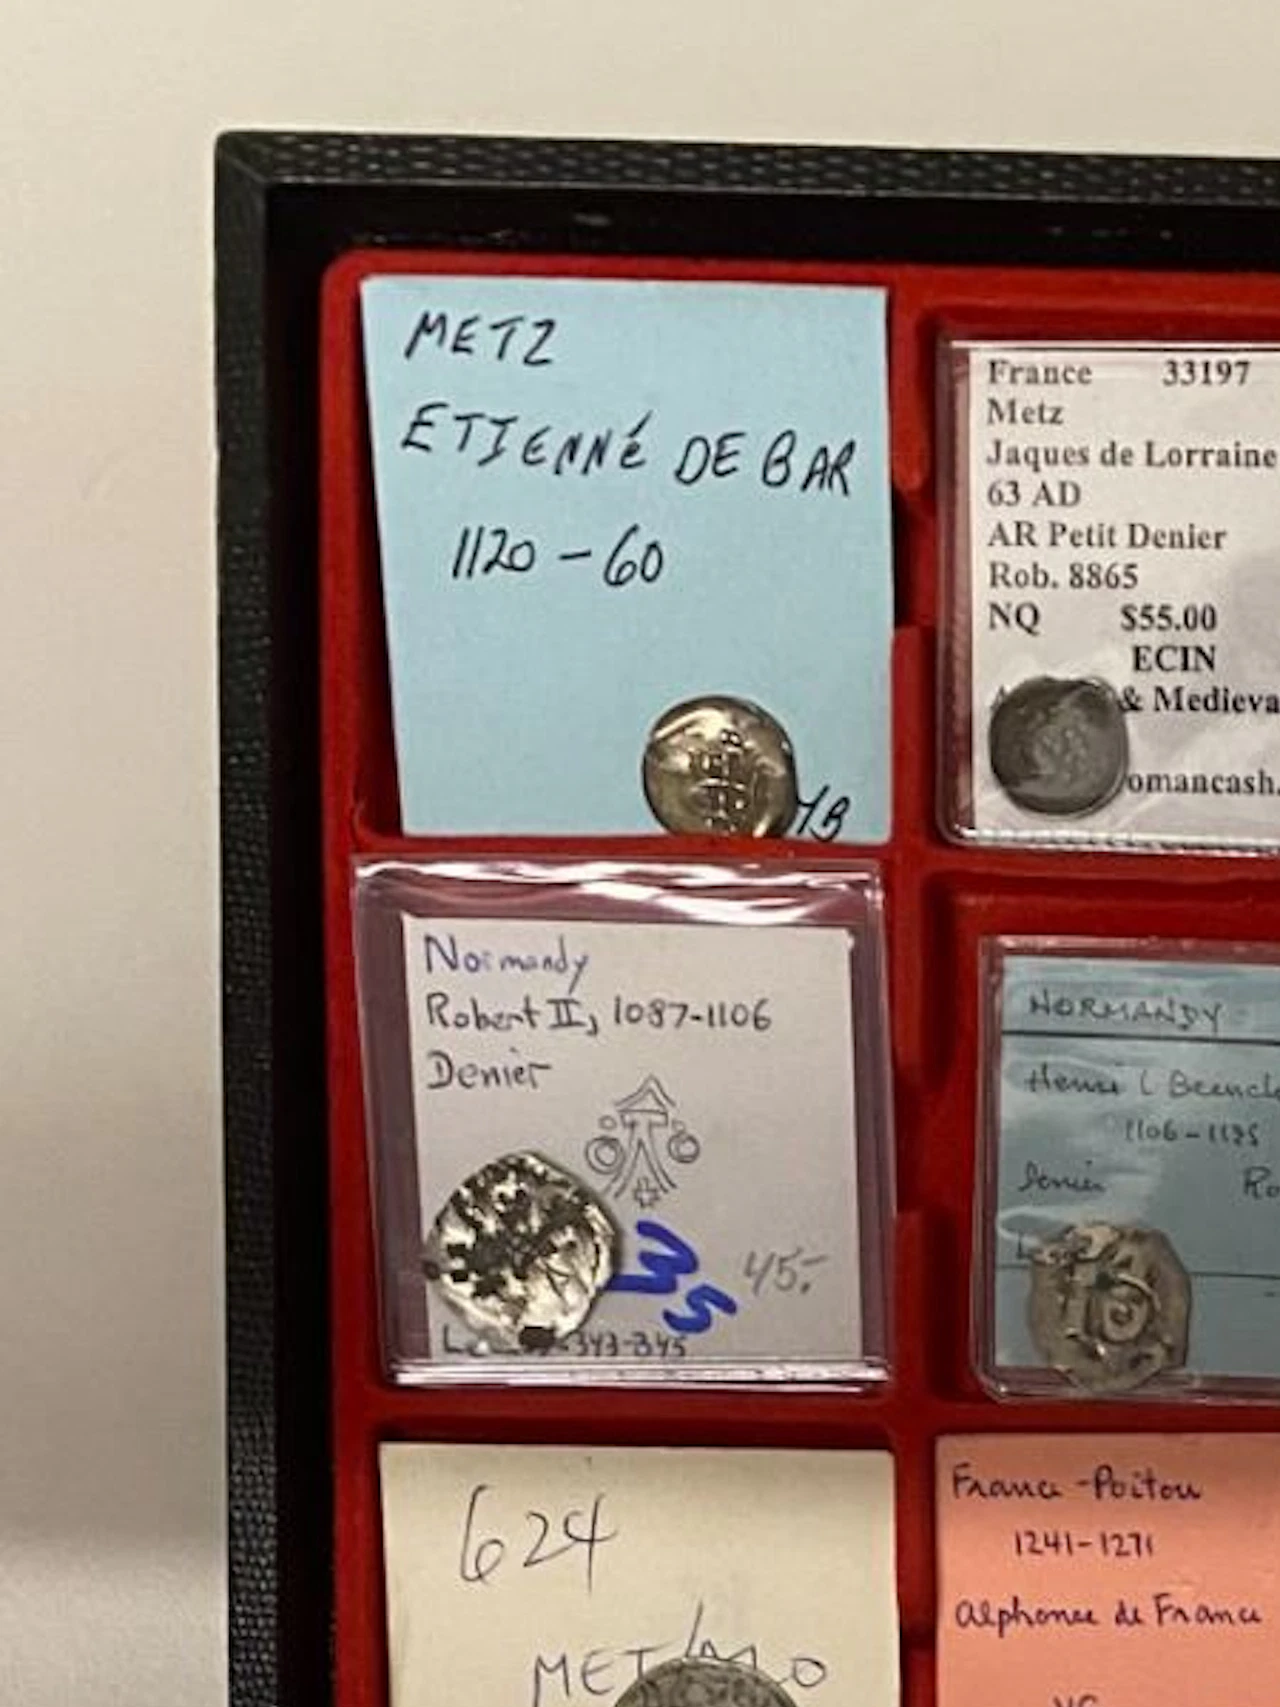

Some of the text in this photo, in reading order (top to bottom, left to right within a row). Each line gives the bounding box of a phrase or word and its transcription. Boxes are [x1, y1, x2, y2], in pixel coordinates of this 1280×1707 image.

[404, 311, 557, 366] METZ
[987, 360, 1251, 387] France 33197
[987, 399, 1064, 426] Metz
[675, 432, 746, 485] DE
[761, 429, 857, 496] BAR
[987, 440, 1090, 473] Jaques
[1100, 442, 1134, 468] de
[1145, 442, 1278, 469] Lorraine
[1121, 604, 1218, 632] $55.00
[1133, 646, 1216, 672] ECIN
[426, 993, 542, 1031] Robert
[612, 997, 773, 1031] 1087-1106
[1028, 989, 1223, 1033] NORMANDY
[426, 1048, 552, 1090] Denier
[459, 1484, 620, 1592] 624
[1014, 1530, 1155, 1557] 1241-1271
